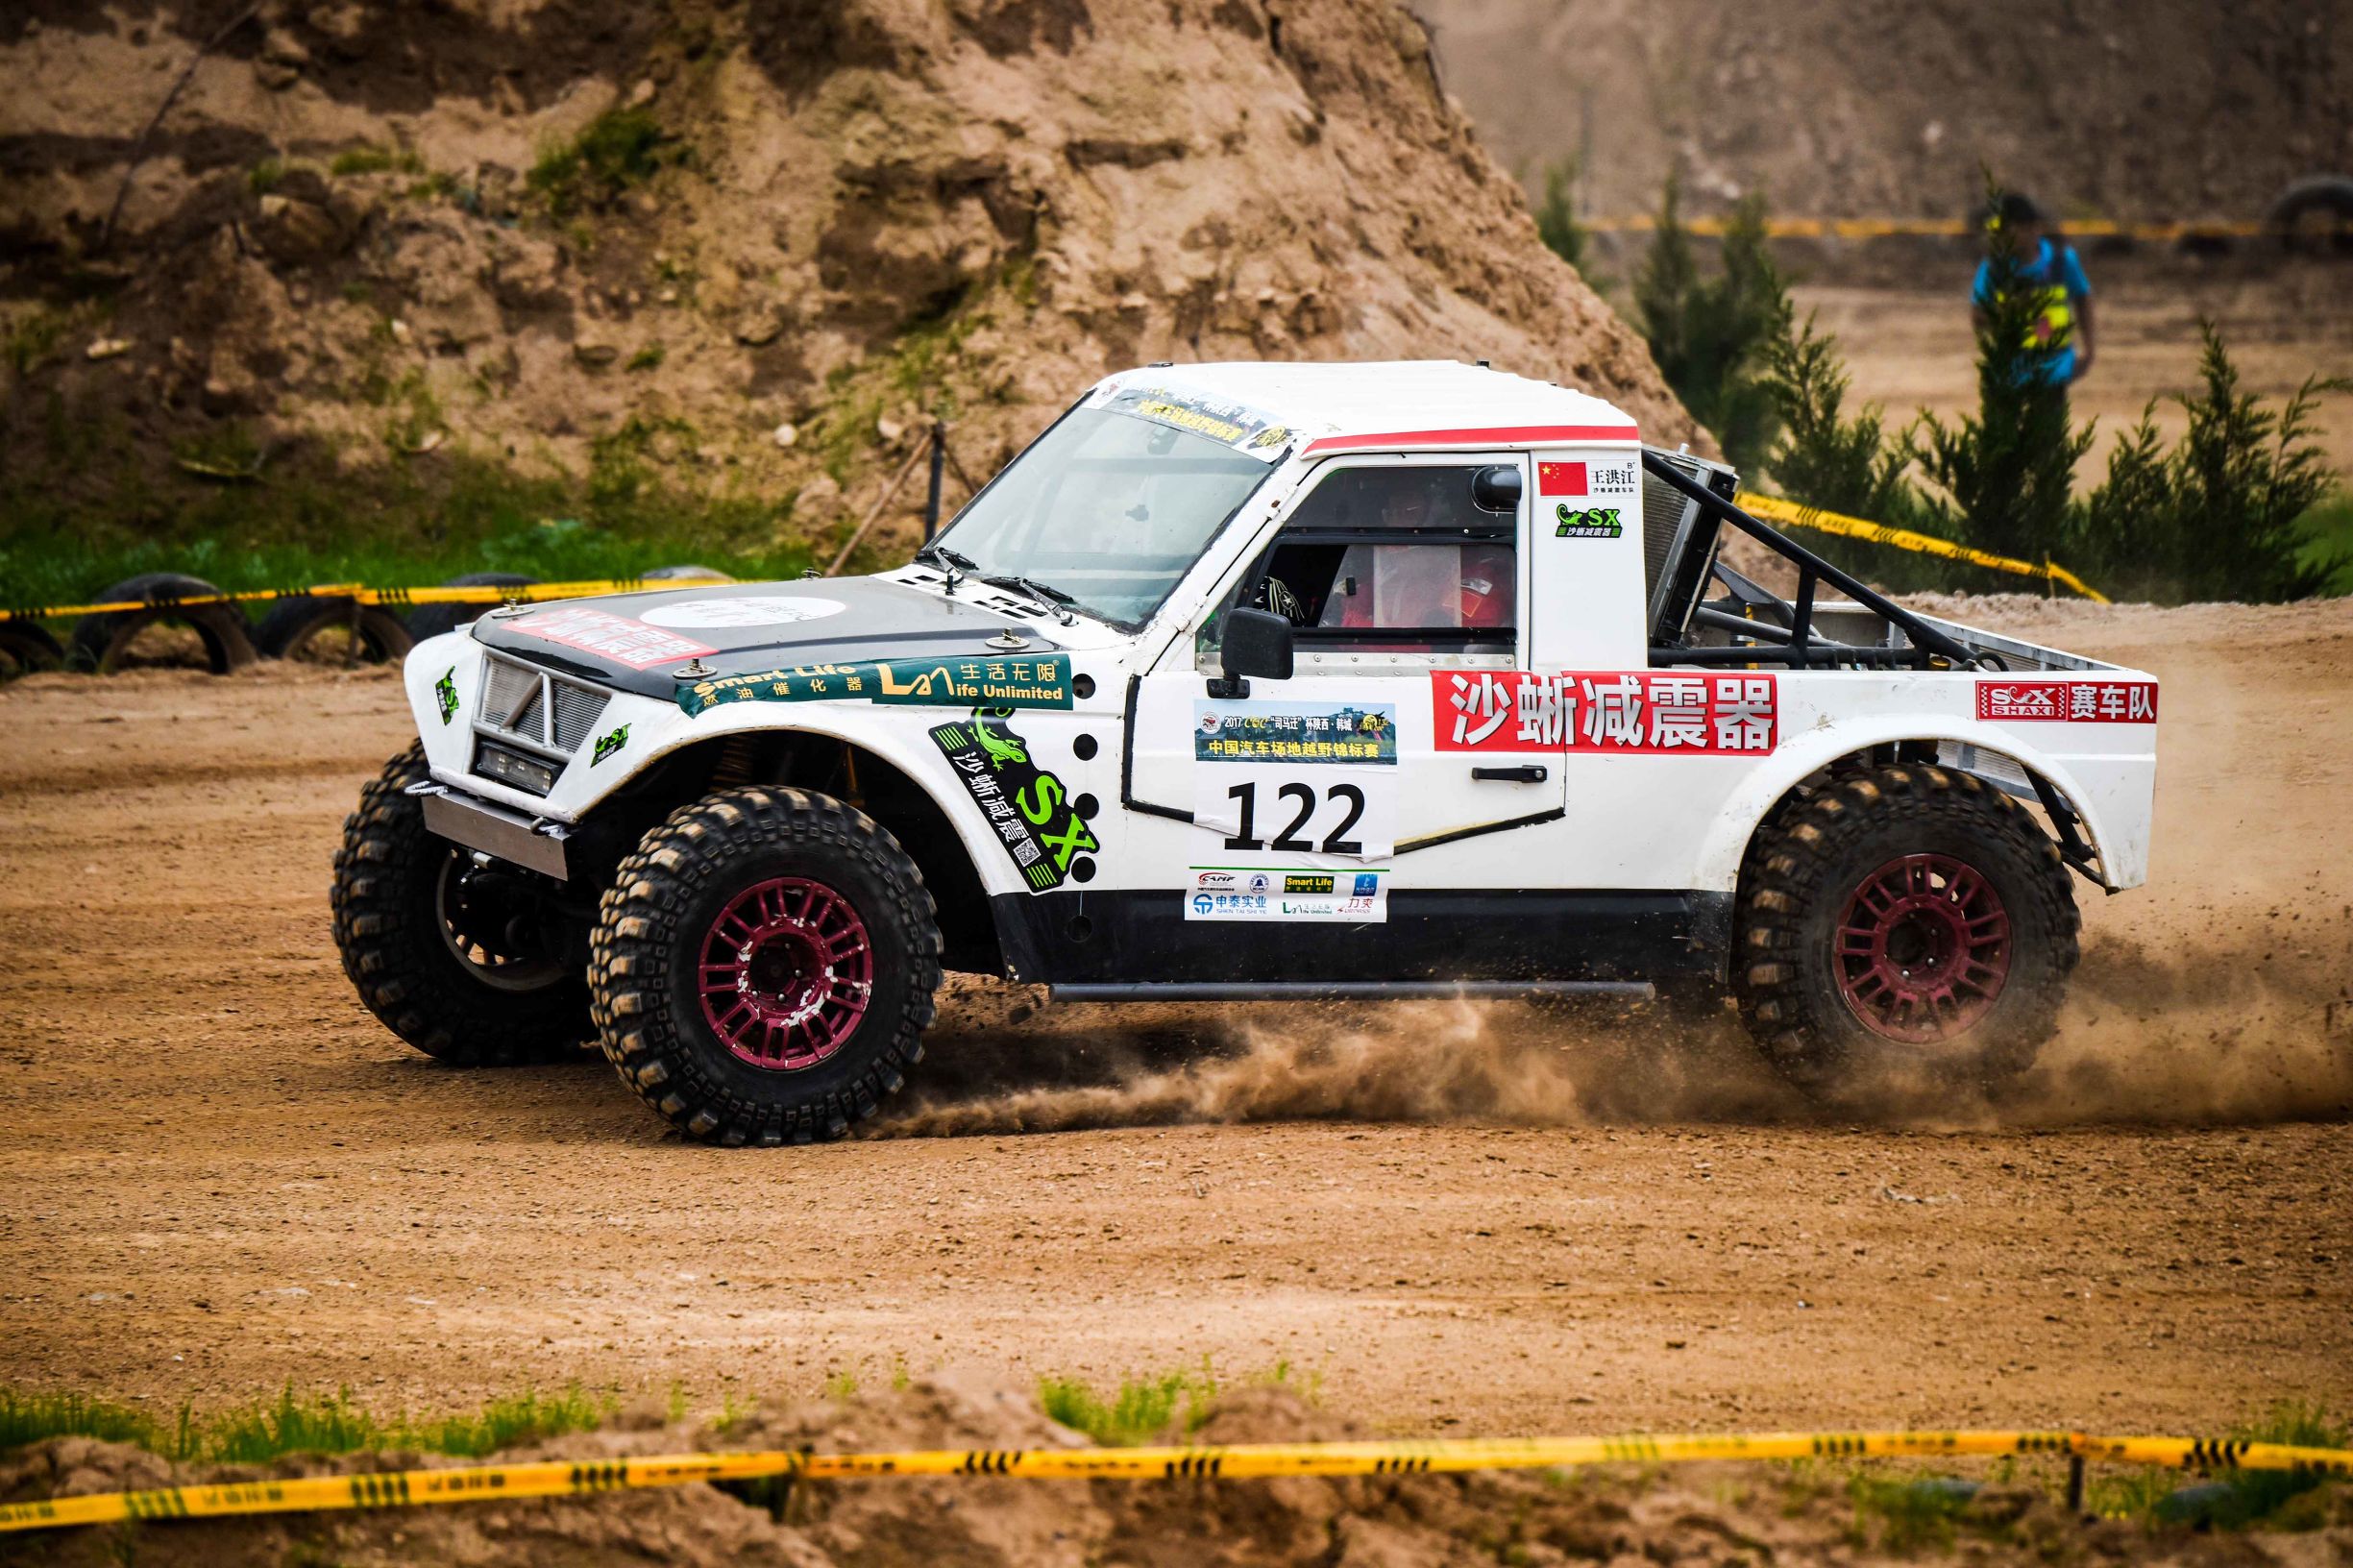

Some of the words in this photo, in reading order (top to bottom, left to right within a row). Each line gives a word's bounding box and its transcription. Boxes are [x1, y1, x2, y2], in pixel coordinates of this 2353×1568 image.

[1591, 469, 1635, 484] 王洪江
[1587, 508, 1620, 527] SX
[693, 669, 789, 698] Smart
[795, 664, 857, 677] Life
[960, 663, 1056, 681] 生活无限
[703, 676, 862, 707] 燃油催化器
[983, 684, 1063, 699] Unlimited
[1449, 674, 1774, 749] 沙蜥减震器
[1993, 706, 2054, 716] SHAXI
[2071, 684, 2155, 721] 赛车队
[1224, 716, 1242, 728] 2017
[1209, 739, 1379, 758] 中国汽车场地越野锦标赛
[1015, 774, 1096, 872] SX
[1224, 781, 1365, 854] 122
[1287, 877, 1313, 886] Smart
[1315, 877, 1333, 887] Life
[1215, 894, 1266, 908] 申泰实业
